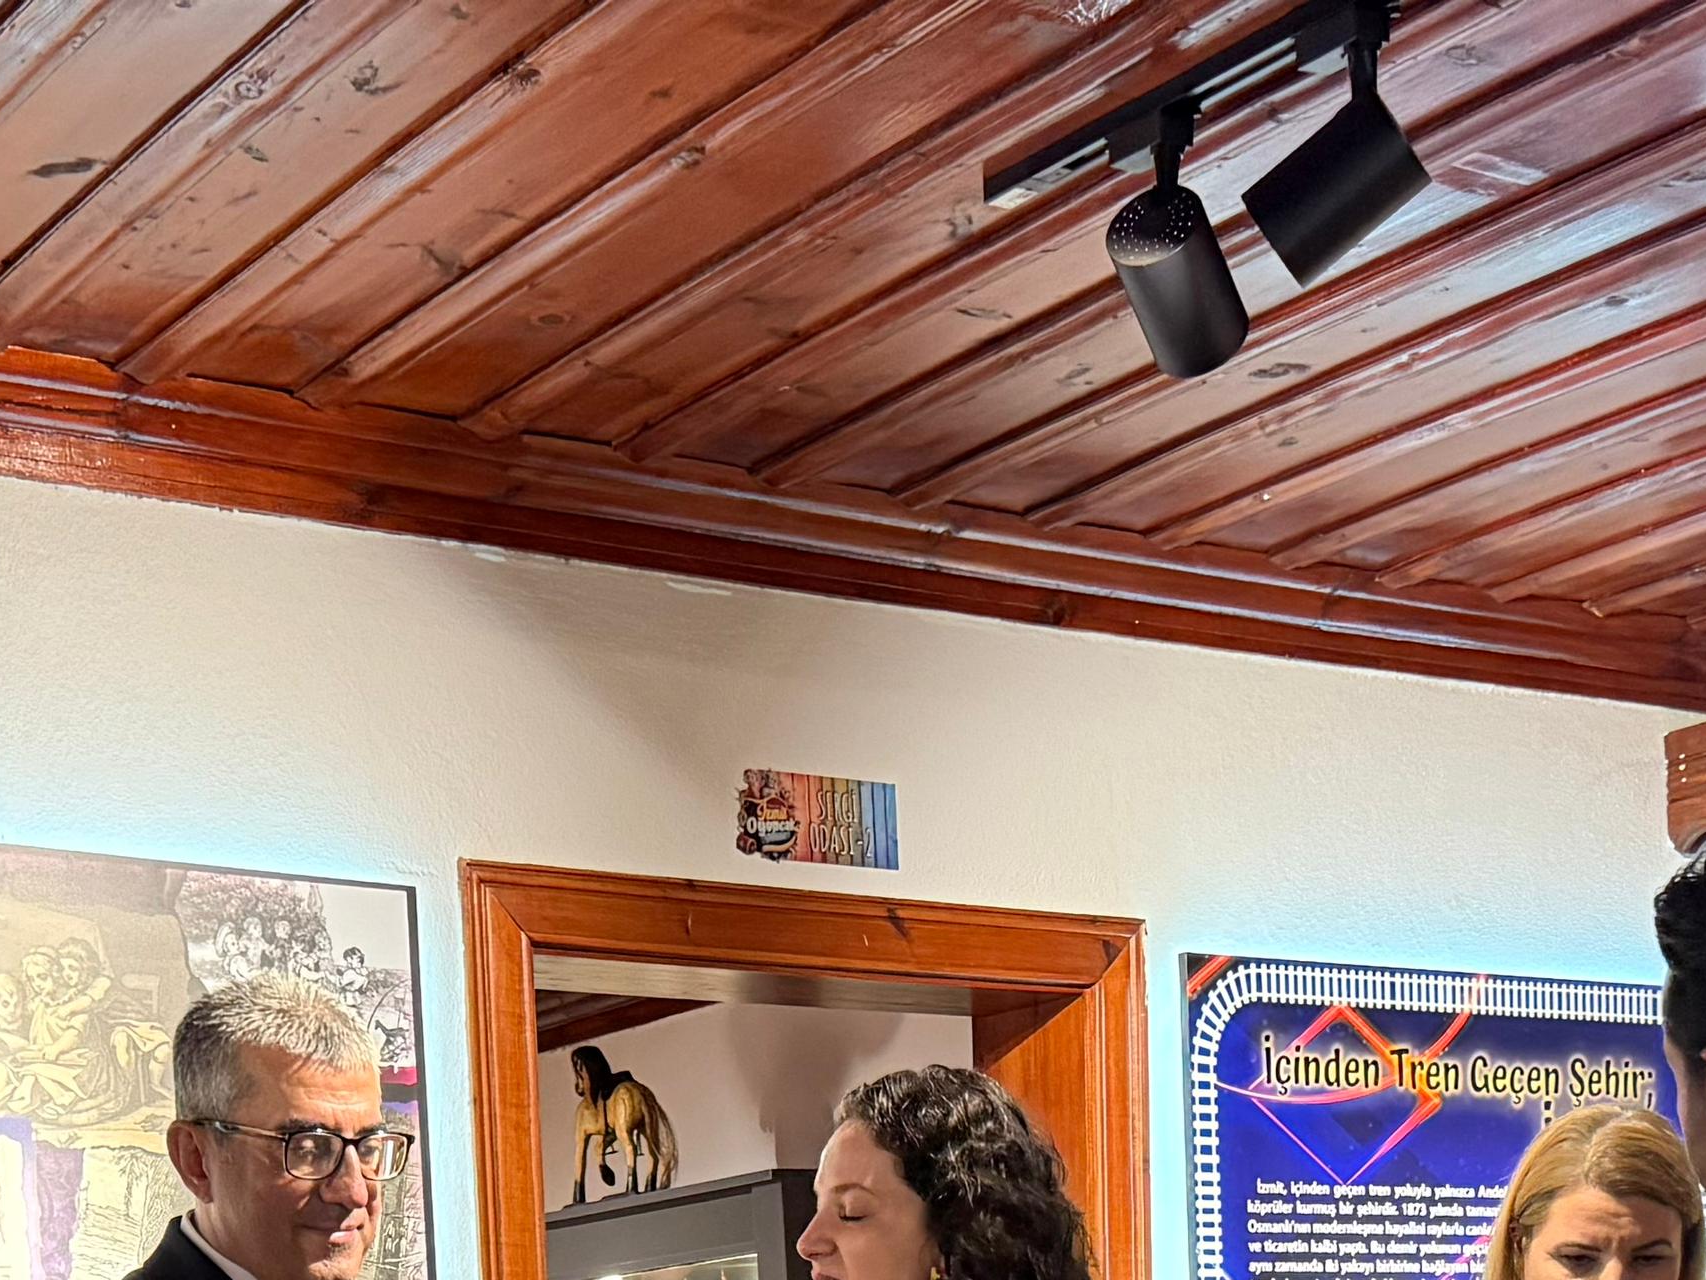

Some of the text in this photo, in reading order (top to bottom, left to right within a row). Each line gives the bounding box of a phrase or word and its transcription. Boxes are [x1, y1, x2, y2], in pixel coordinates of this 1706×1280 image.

[817, 790, 858, 823] SERGİ
[1262, 1035, 1654, 1108] İçinden Tren Geçen Şehir;
[1248, 1241, 1261, 1252] ve
